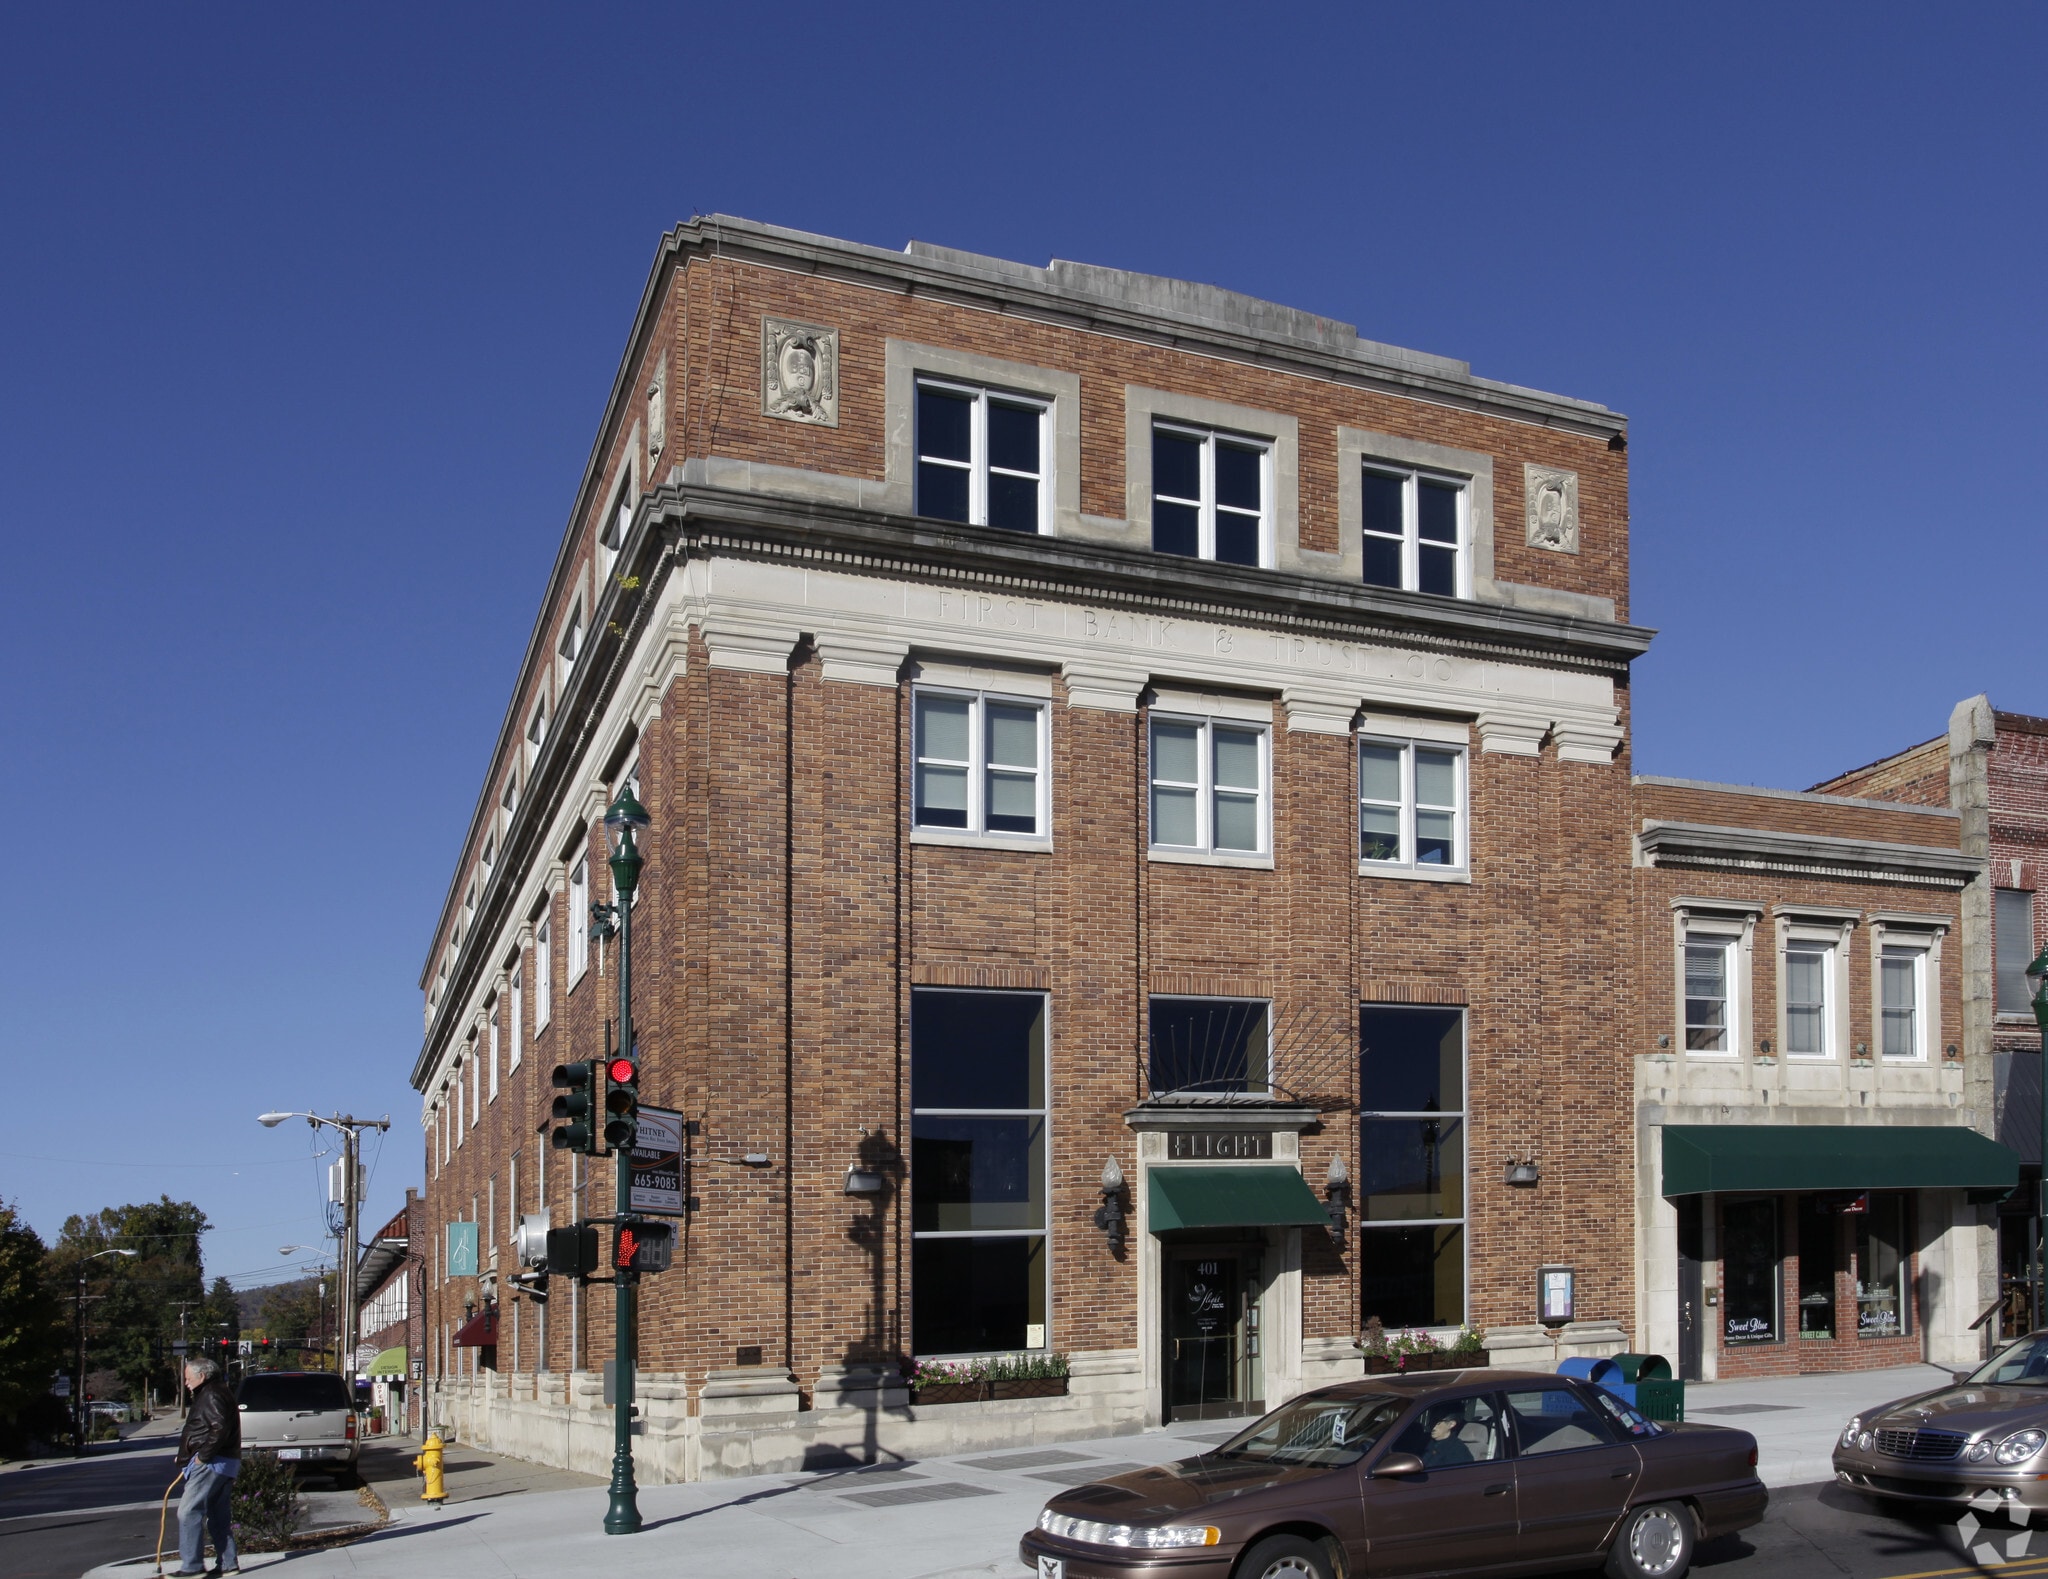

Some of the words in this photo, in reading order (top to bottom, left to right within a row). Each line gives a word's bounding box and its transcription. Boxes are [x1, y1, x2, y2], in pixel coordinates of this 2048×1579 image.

[938, 591, 1043, 629] FIRST
[1083, 610, 1176, 646] BANK
[1216, 628, 1233, 653] &
[1269, 635, 1373, 671] TRUST
[1175, 1135, 1266, 1156] FLIGHT
[631, 1148, 660, 1160] AVAILABLE
[634, 1173, 676, 1190] 665-9085
[1197, 1262, 1218, 1275] 401
[1728, 1319, 1749, 1333] Sweet
[1750, 1318, 1768, 1332] Blue
[1860, 1312, 1879, 1326] Sweet
[1879, 1311, 1897, 1325] Blue
